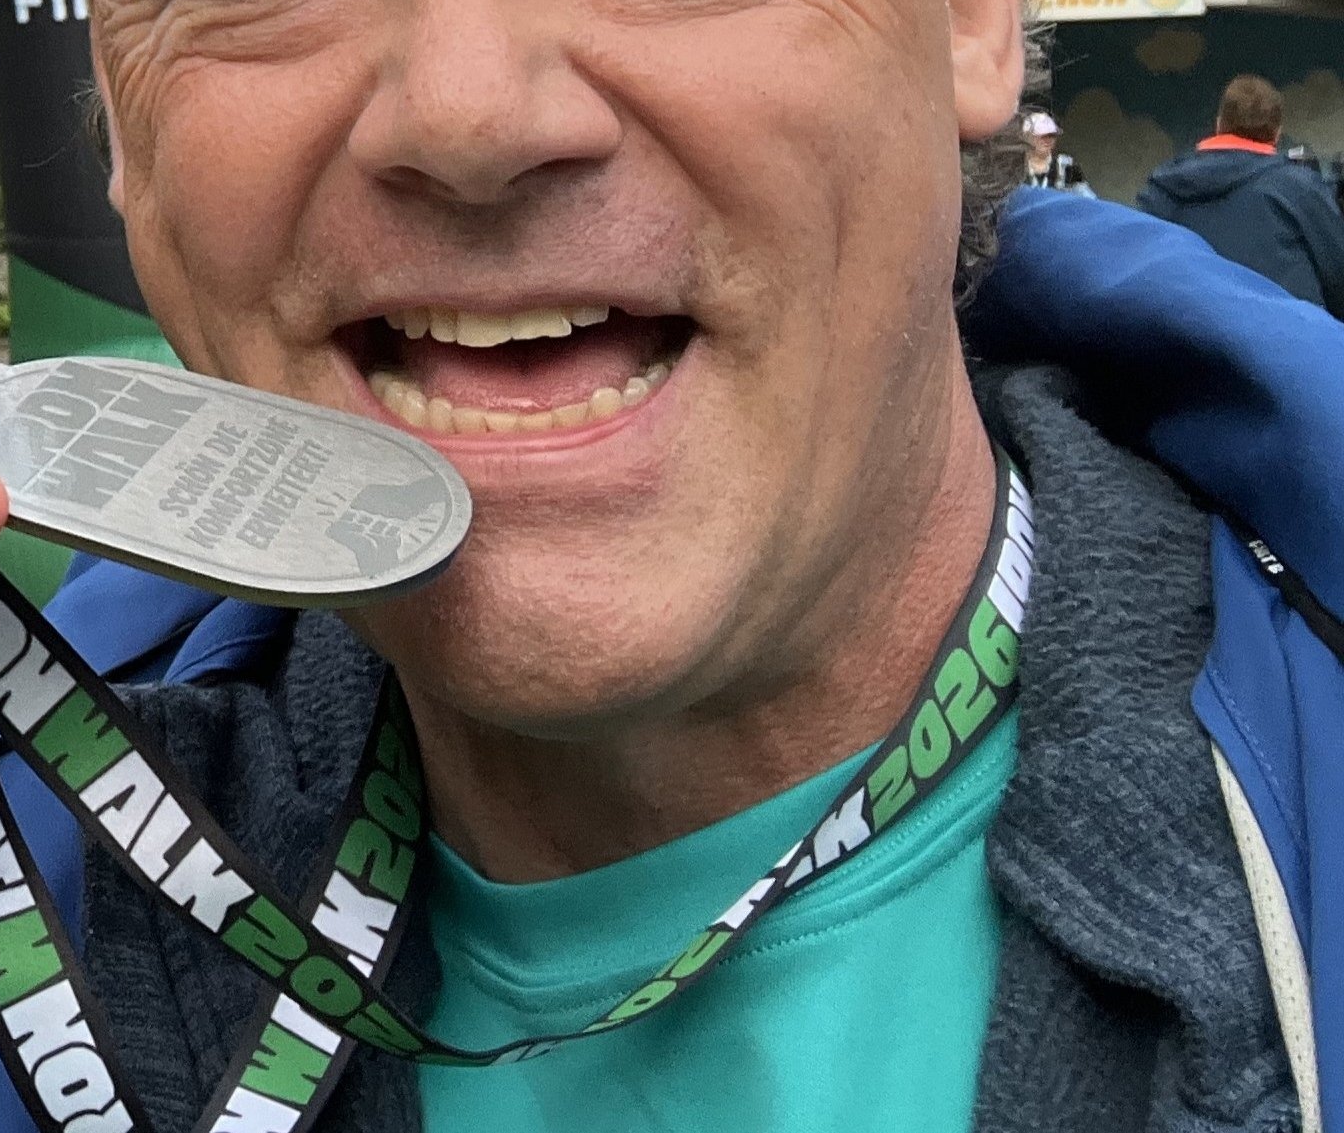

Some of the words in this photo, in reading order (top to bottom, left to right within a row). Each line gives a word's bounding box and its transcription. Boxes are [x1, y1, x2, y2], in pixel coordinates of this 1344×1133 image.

[25, 380, 208, 508] WALK
[158, 453, 225, 518] SCHÖN
[204, 420, 248, 457] DIE
[184, 416, 299, 549] KOMFORTZONE
